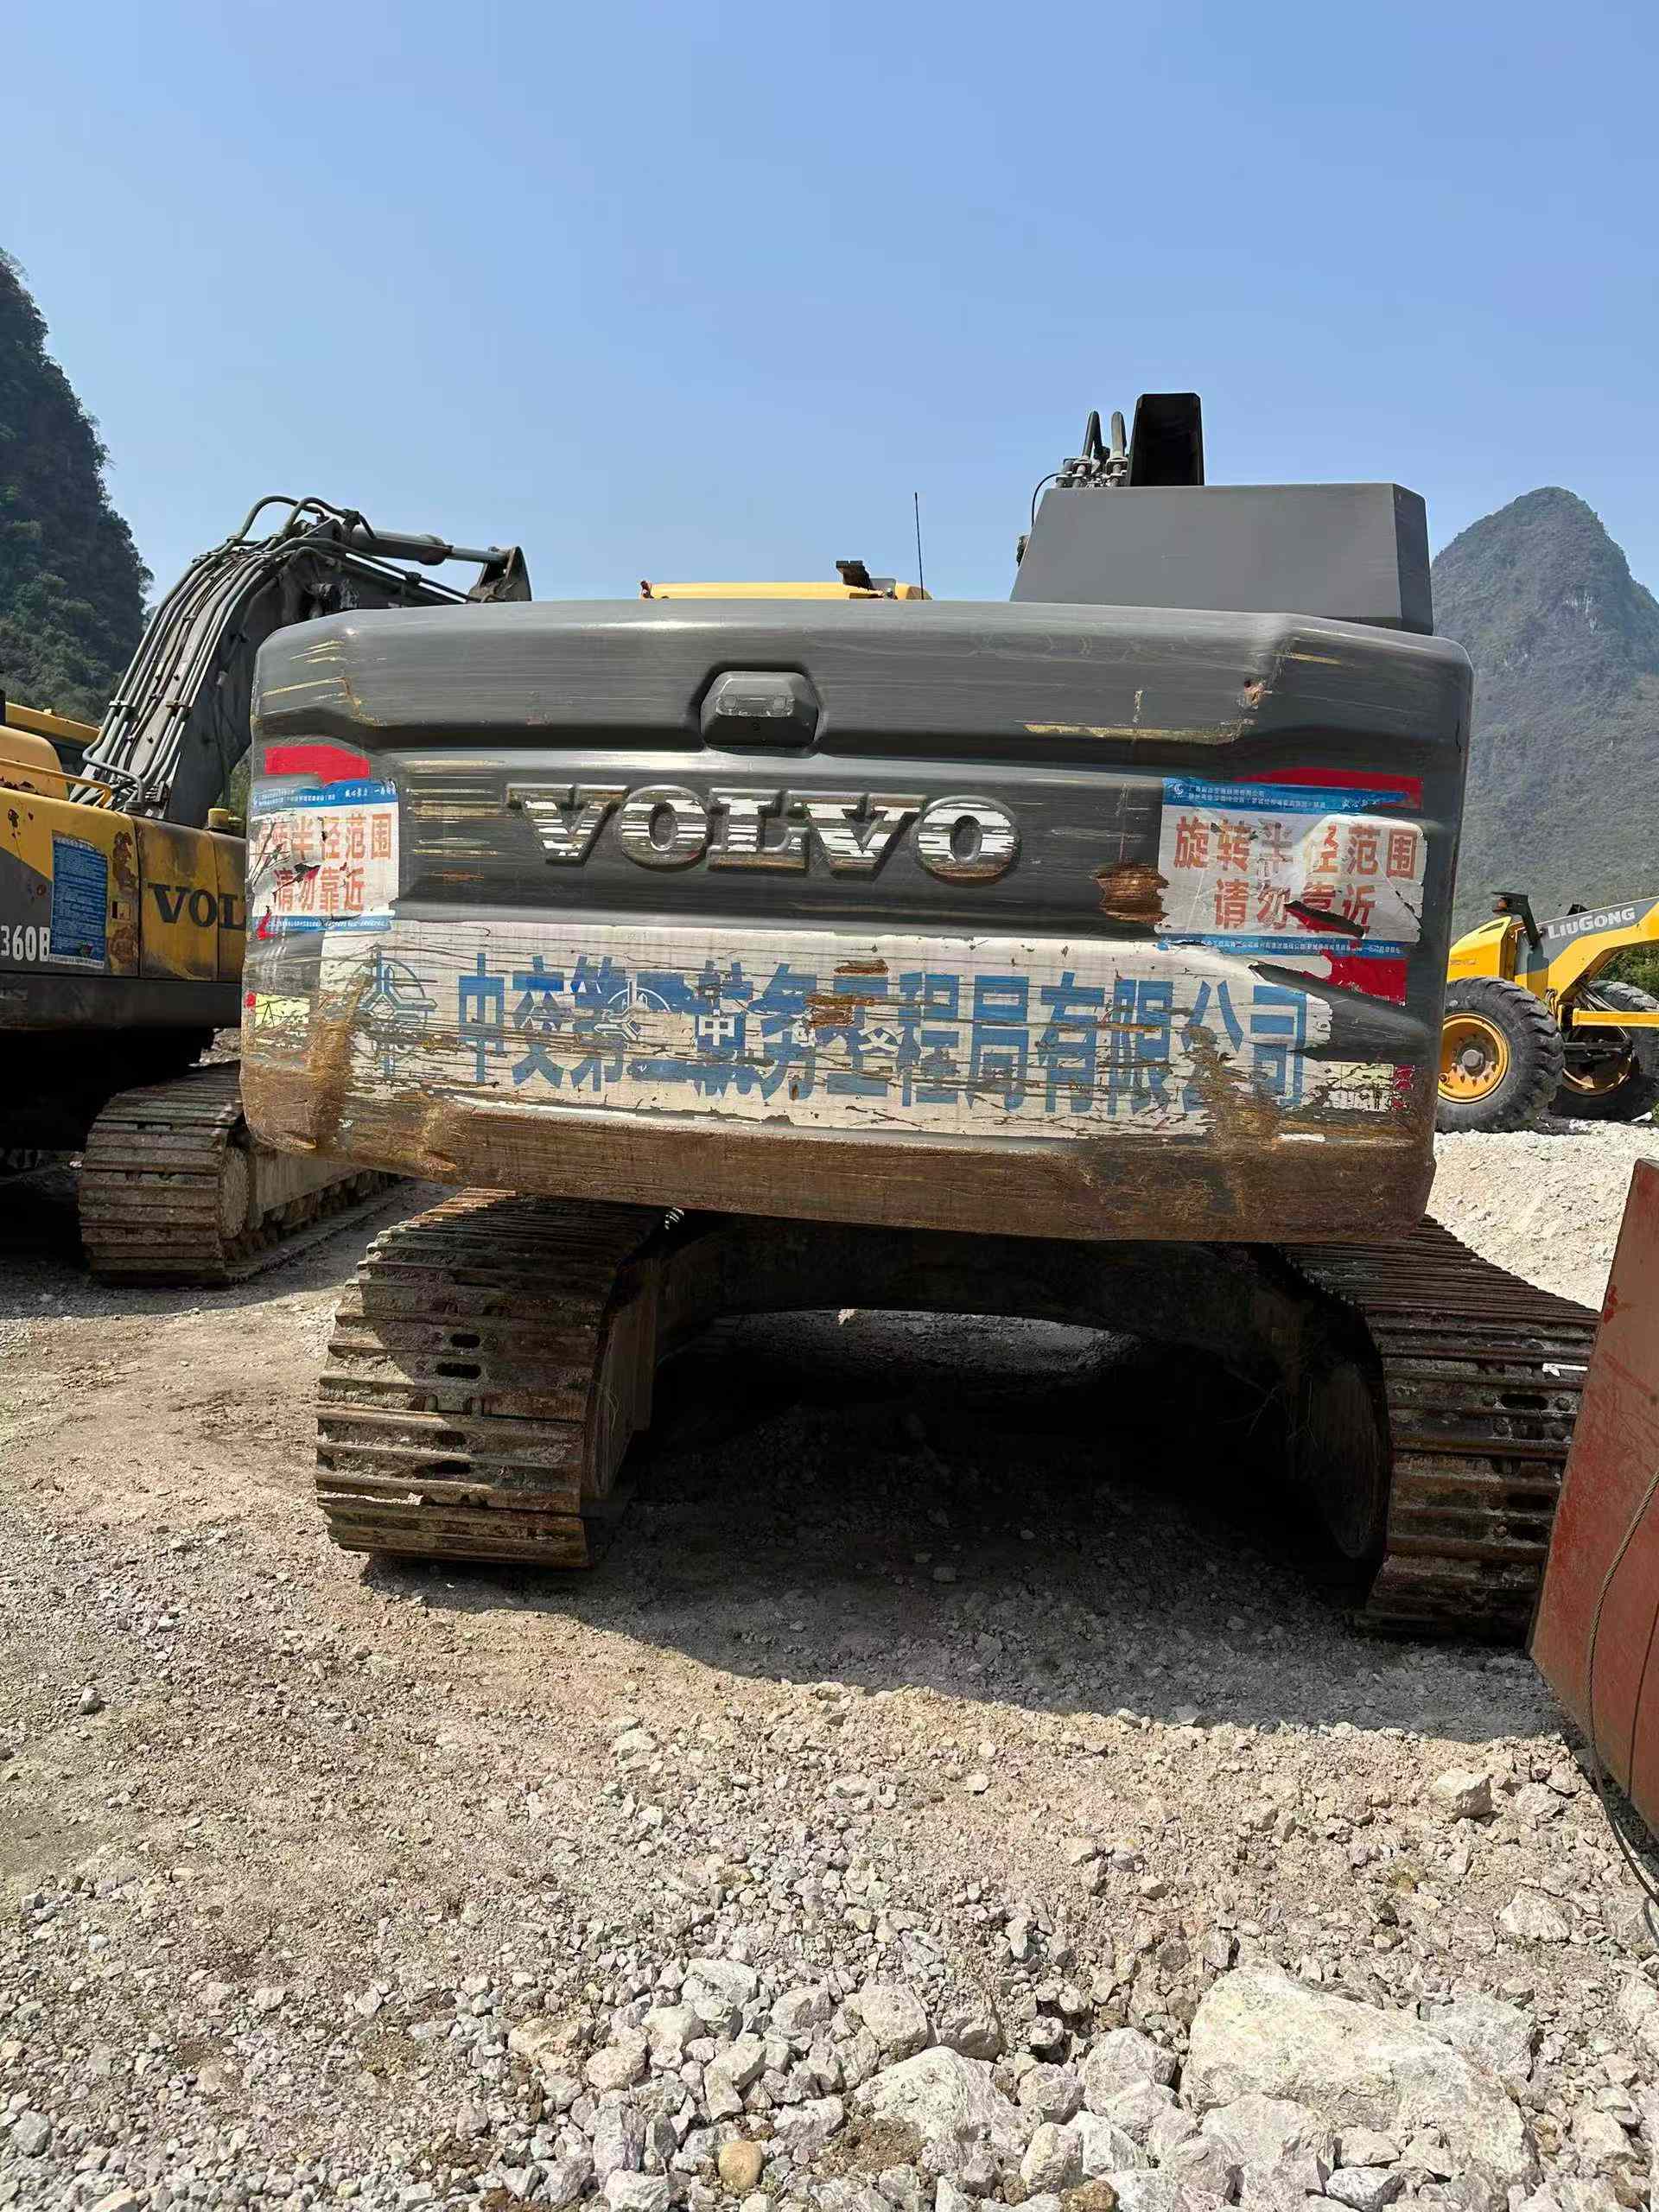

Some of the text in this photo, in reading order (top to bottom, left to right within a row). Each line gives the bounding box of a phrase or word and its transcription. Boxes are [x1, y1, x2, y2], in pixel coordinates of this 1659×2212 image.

[505, 783, 1020, 882] VOLVO
[148, 882, 245, 931] VOL
[0, 925, 50, 962] 360B
